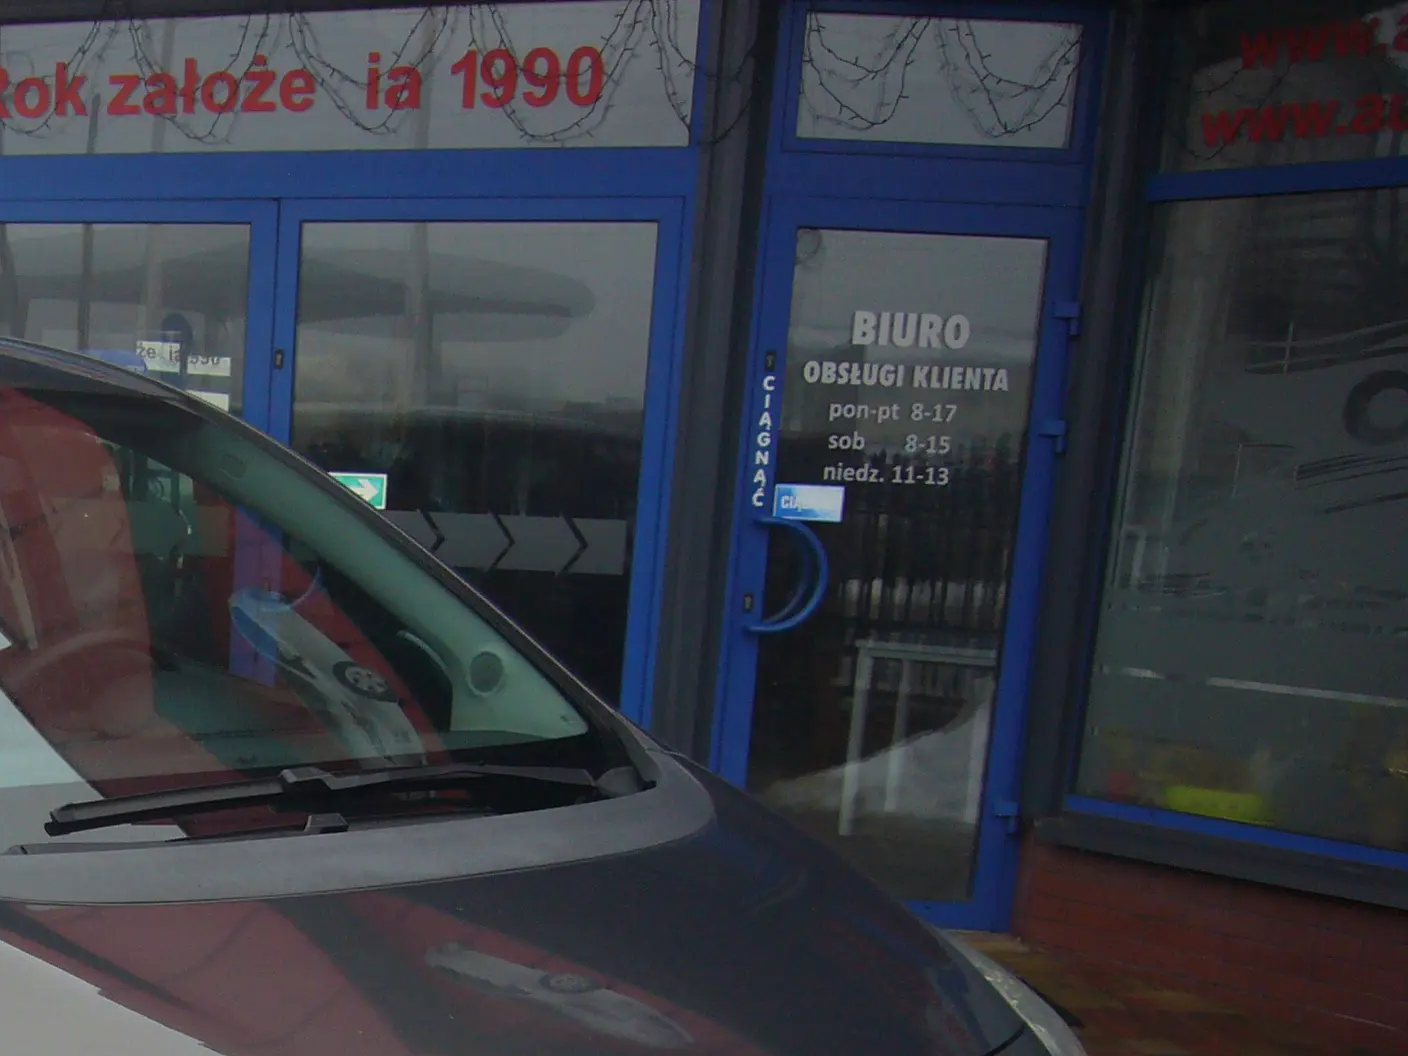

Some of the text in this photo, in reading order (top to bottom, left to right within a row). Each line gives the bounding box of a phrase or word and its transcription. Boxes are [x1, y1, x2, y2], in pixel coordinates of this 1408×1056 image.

[107, 53, 316, 117] założe
[366, 53, 422, 111] ia
[450, 45, 605, 110] 1990
[852, 310, 970, 350] BIURO
[804, 360, 1010, 392] OBSŁUGI KLIENTA
[828, 402, 958, 424] pon-pt 8-17
[752, 375, 776, 507] CIĄGNĄĆ
[828, 431, 951, 454] sob 8-15
[823, 462, 950, 487] niedz. 11-13
